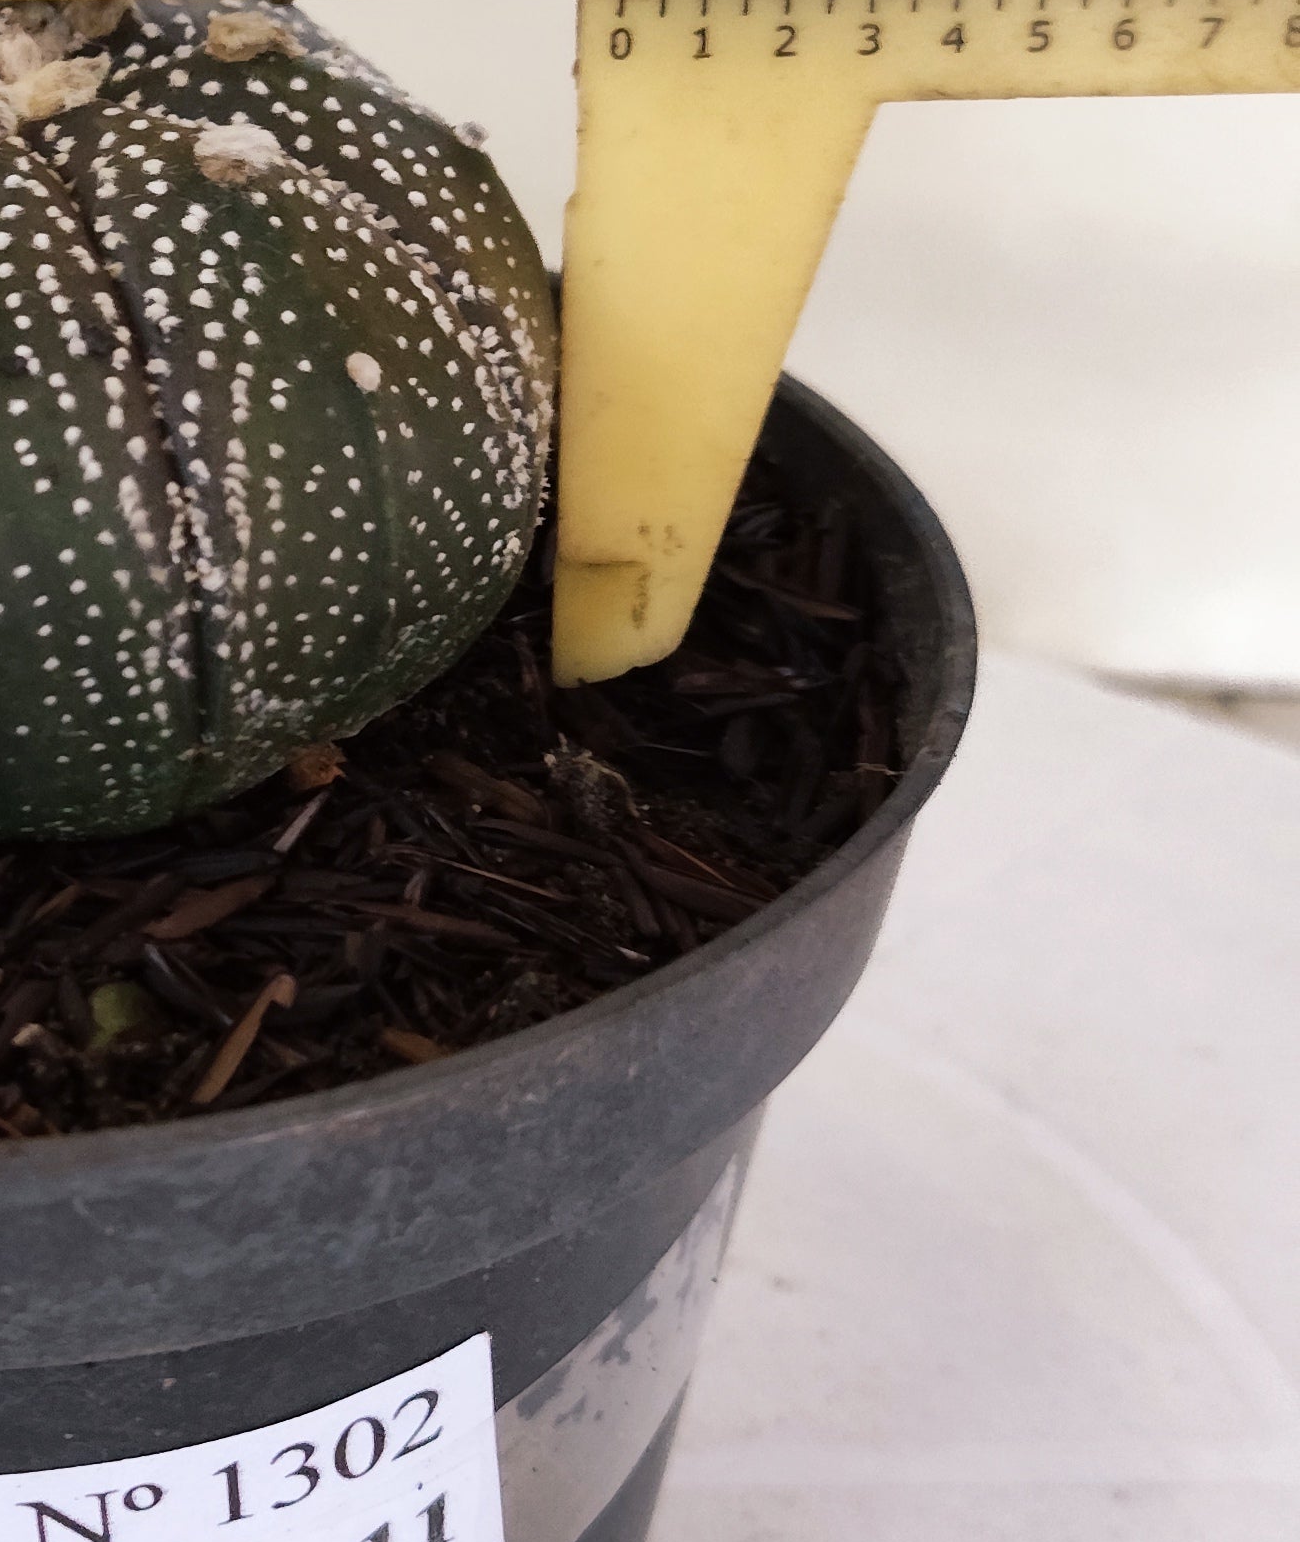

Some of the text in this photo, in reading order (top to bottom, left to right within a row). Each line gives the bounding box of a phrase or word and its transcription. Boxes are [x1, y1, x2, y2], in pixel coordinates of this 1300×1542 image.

[609, 27, 634, 61] 0
[693, 27, 712, 60] 1
[773, 24, 797, 58] 2
[857, 22, 881, 56] 3
[941, 22, 966, 53] 4
[1027, 19, 1052, 53] 5
[1112, 17, 1137, 51] 6
[1199, 15, 1227, 49] 7
[212, 1388, 445, 1527] 1302
